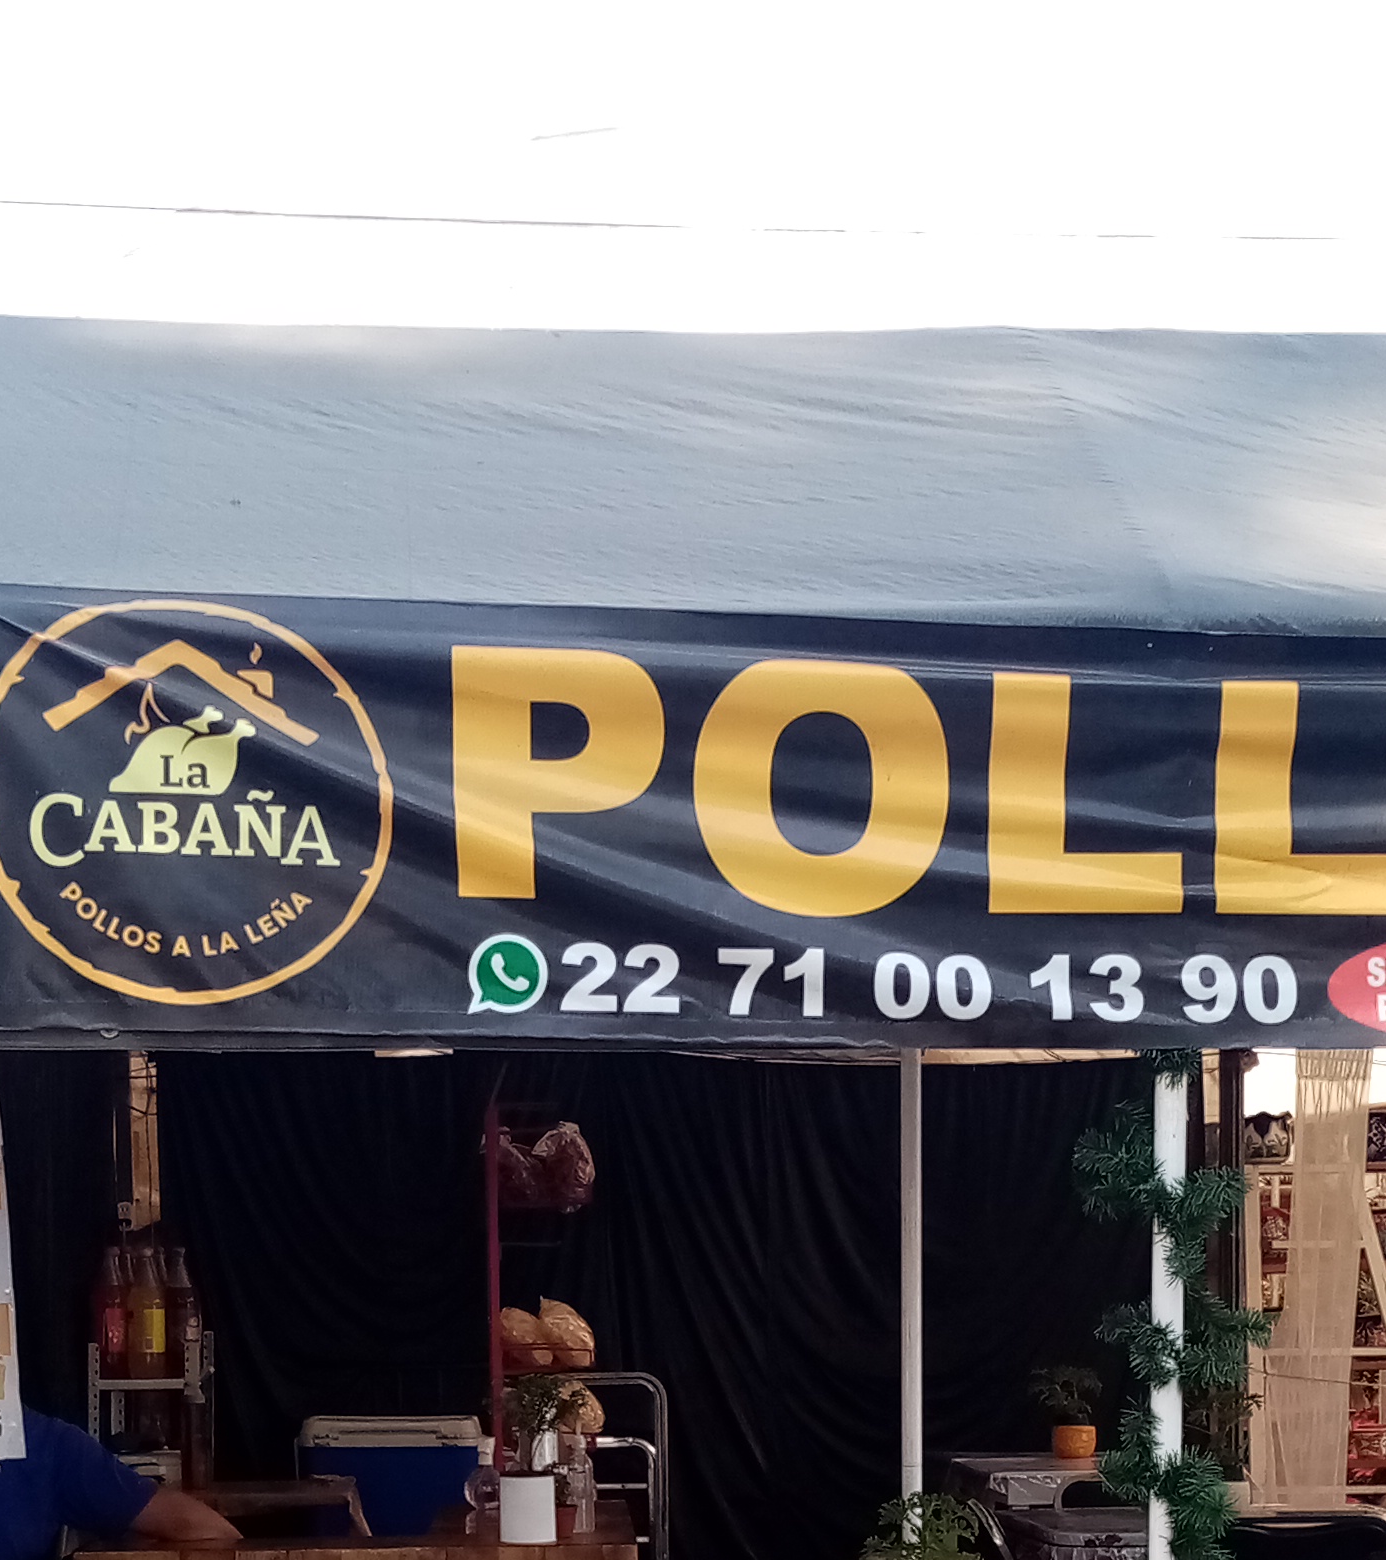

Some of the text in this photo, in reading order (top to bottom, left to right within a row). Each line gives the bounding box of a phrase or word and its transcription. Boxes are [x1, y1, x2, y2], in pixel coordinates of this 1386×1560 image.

[159, 755, 210, 789] La
[29, 789, 341, 867] CABAÑA
[59, 881, 313, 957] POLLOS A LA LEÑA
[559, 942, 1299, 1024] 22 71 00 13 90
